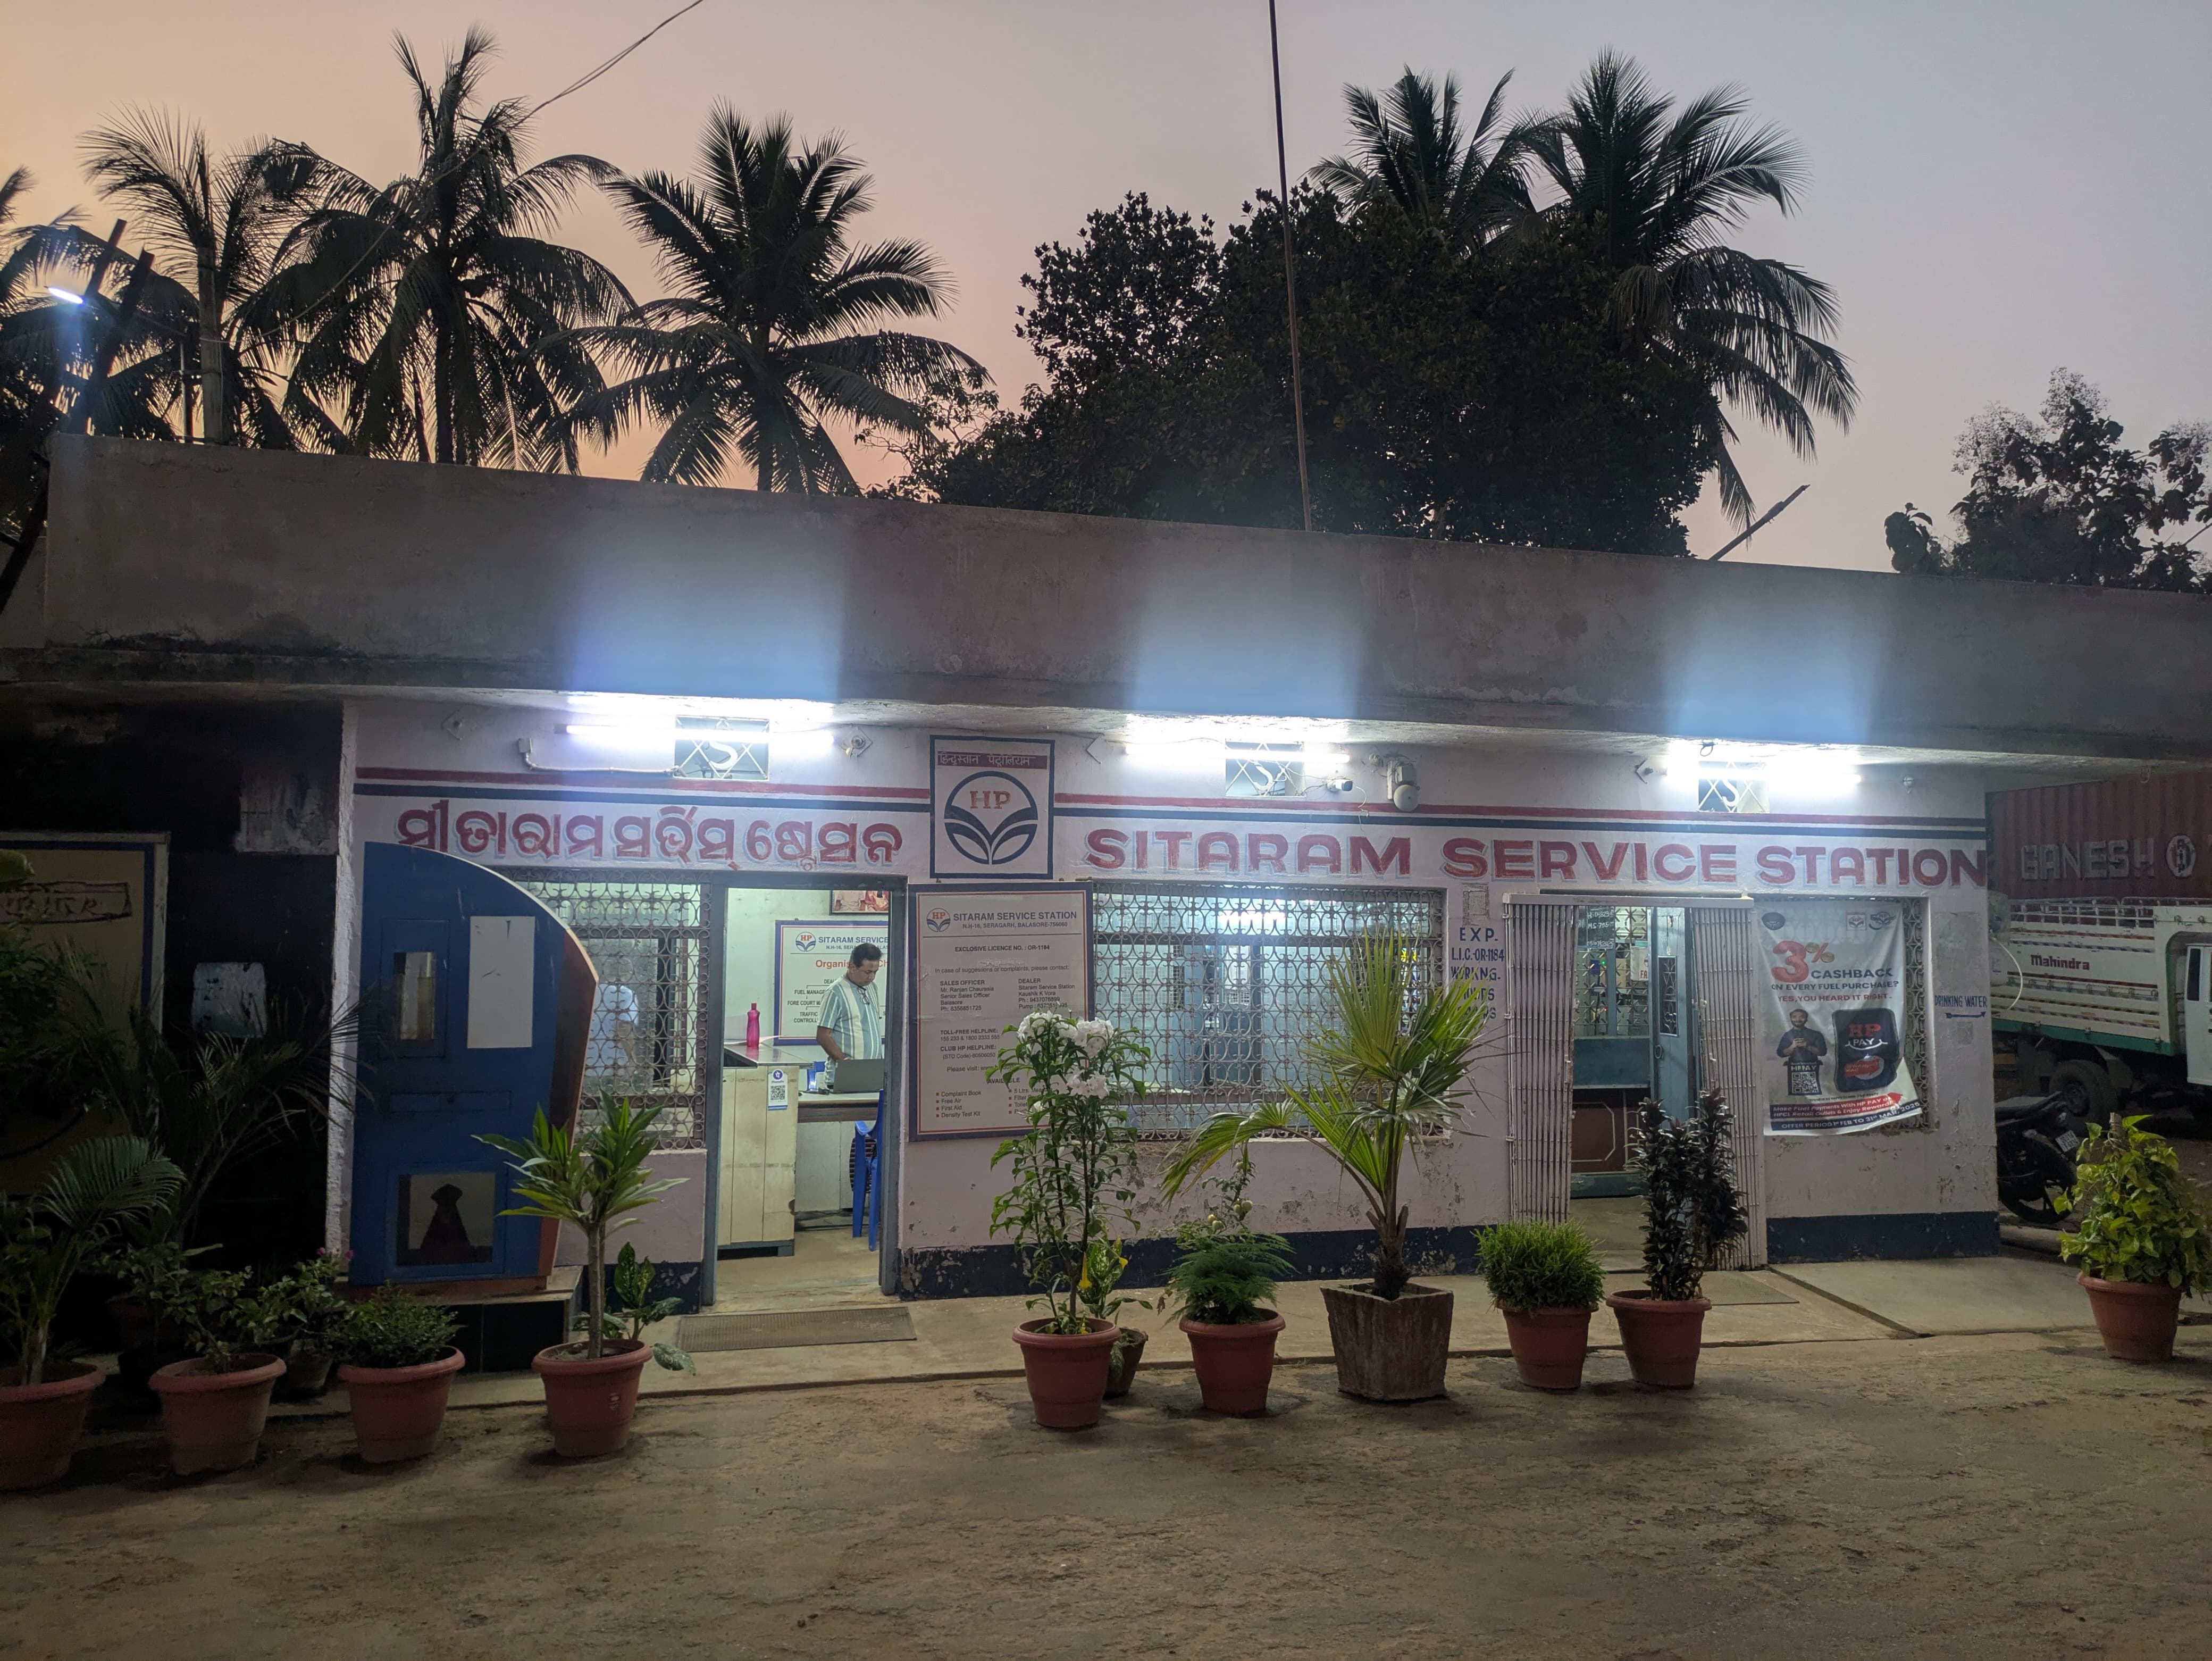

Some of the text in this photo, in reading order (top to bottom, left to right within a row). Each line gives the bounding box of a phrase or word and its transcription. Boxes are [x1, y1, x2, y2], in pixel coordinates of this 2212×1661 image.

[970, 790, 1011, 809] HP
[1085, 829, 1986, 887] SITARAM SERVICE STATION
[2021, 838, 2155, 880] GANESH
[953, 913, 994, 921] SITARAM
[997, 912, 1036, 921] SERVICE
[1038, 911, 1077, 920] STATION
[815, 959, 851, 969] Organis
[2030, 954, 2090, 971] Mahindra
[1811, 967, 1893, 979] CASHBACK
[1842, 981, 1899, 989] PURCHASE?
[1934, 995, 1988, 1008] DRINKING WATER
[1848, 1023, 1881, 1038] HP
[1900, 1102, 1920, 1112] 2025
